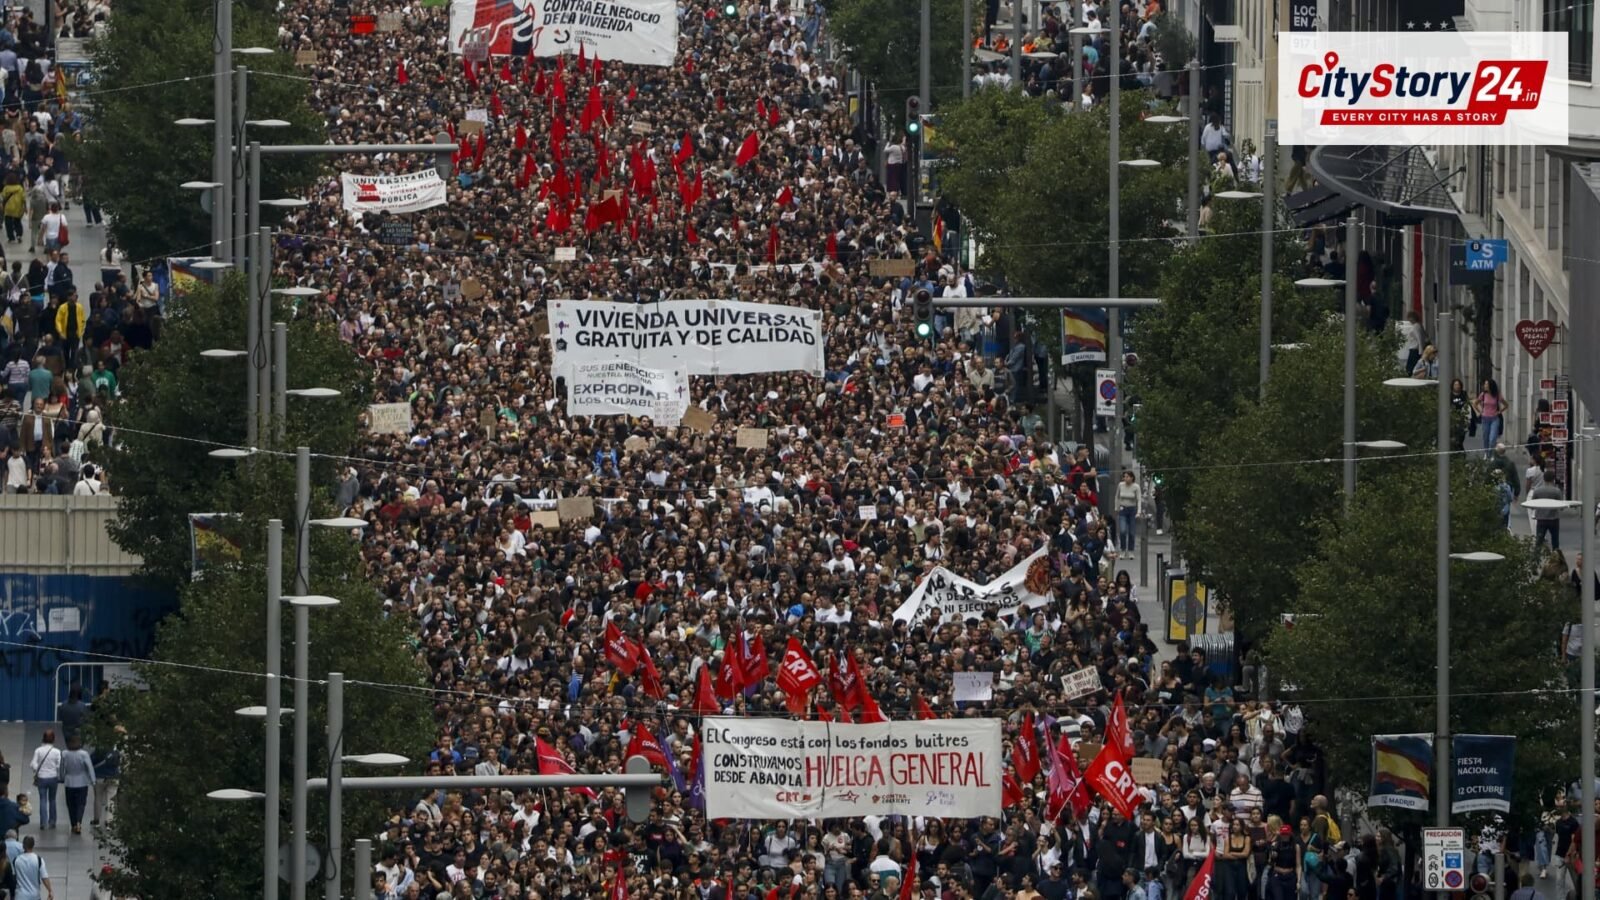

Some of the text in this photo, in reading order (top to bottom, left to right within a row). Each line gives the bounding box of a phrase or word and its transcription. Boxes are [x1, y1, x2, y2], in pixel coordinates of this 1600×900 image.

[543, 0, 660, 24] CONTRA EL NEGOCIO
[543, 12, 633, 32] DE LA VIVIENDA
[1294, 17, 1308, 27] EN
[352, 169, 436, 184] UNIVERSITARIO
[1481, 243, 1494, 258] S
[1471, 260, 1494, 269] ATM
[576, 309, 679, 330] VIVIENDA
[684, 308, 813, 330] UNIVERSAL
[575, 328, 815, 349] GRATUITA Y DE CALIDAD
[579, 362, 665, 379] SUS BENEFICIOS
[573, 383, 669, 400] EXPROPIAR
[604, 397, 654, 408] CULPABL
[944, 604, 955, 613] NI
[783, 650, 817, 682] CRT
[706, 728, 720, 743] El
[722, 728, 777, 749] Congreso
[781, 735, 805, 749] está
[808, 738, 831, 748] con
[860, 735, 908, 749] fondos
[915, 733, 969, 748] buitres
[714, 753, 802, 770] CONSTRUYAMOS
[1457, 757, 1482, 766] FIESTA
[805, 752, 991, 788] HUELGA GENERAL
[1457, 767, 1499, 776] NACIONAL
[714, 771, 803, 787] DESDE ABAJO LA
[1104, 760, 1139, 803] CRT
[776, 791, 800, 803] CRT
[1458, 786, 1505, 796] 12 OCTUBRE
[1388, 797, 1416, 806] MADRID
